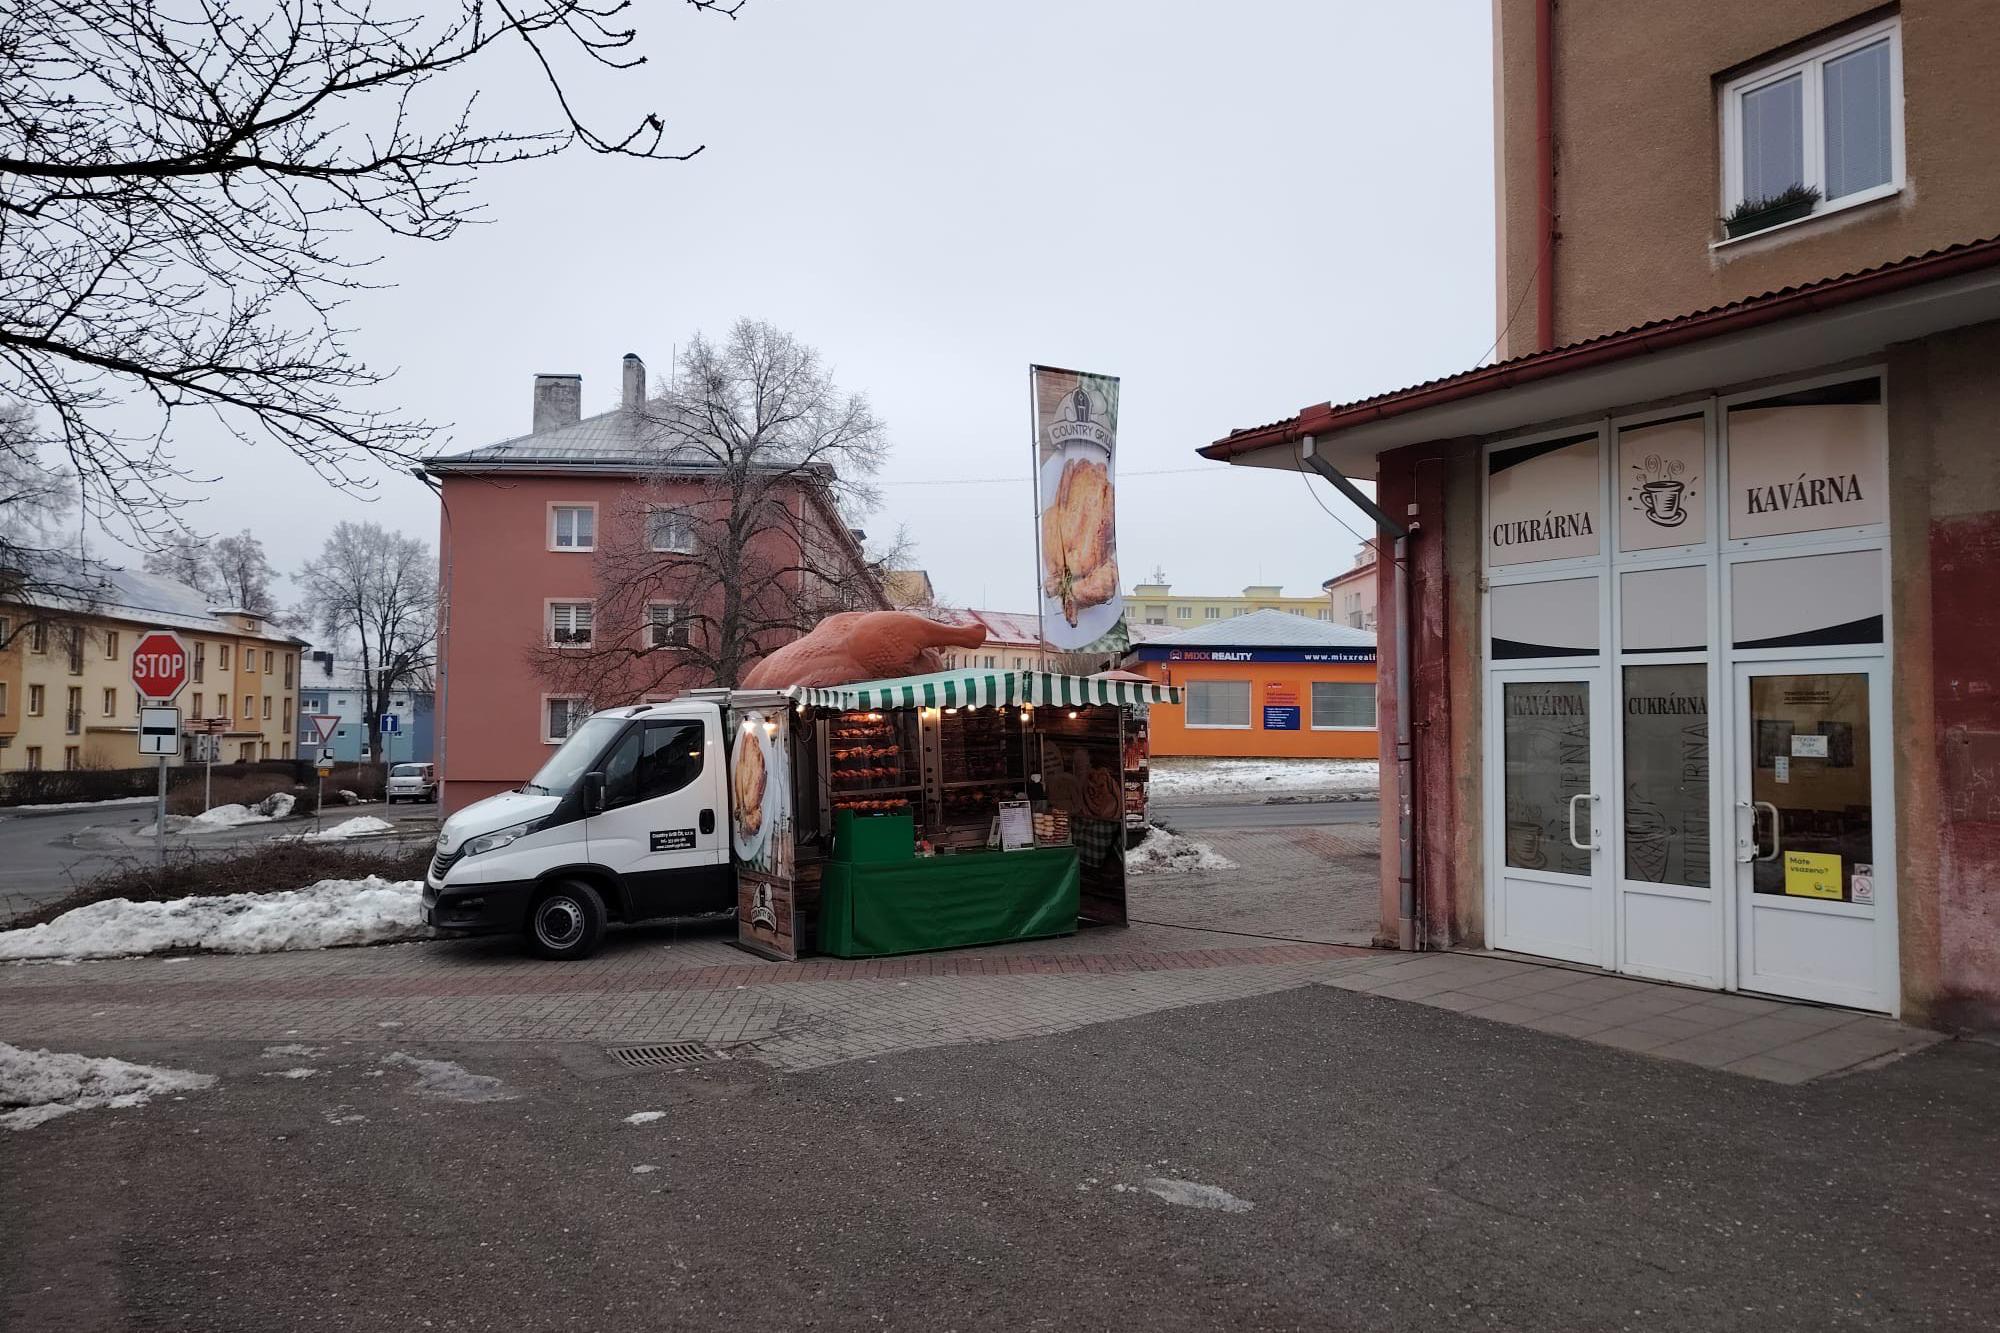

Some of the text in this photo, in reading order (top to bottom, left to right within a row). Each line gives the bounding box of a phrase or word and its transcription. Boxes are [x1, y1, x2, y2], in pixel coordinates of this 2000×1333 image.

[1052, 424, 1093, 439] COUNTRY
[1746, 473, 1864, 515] KAVÁRNA
[1492, 510, 1593, 547] CUKRÁRNA
[135, 653, 183, 678] STOP
[1184, 651, 1253, 661] MIXX REALITY
[1304, 652, 1379, 662] www.mixxreali
[1513, 690, 1585, 716] KAVÁRNA
[1628, 692, 1708, 715] CUKRÁRNA
